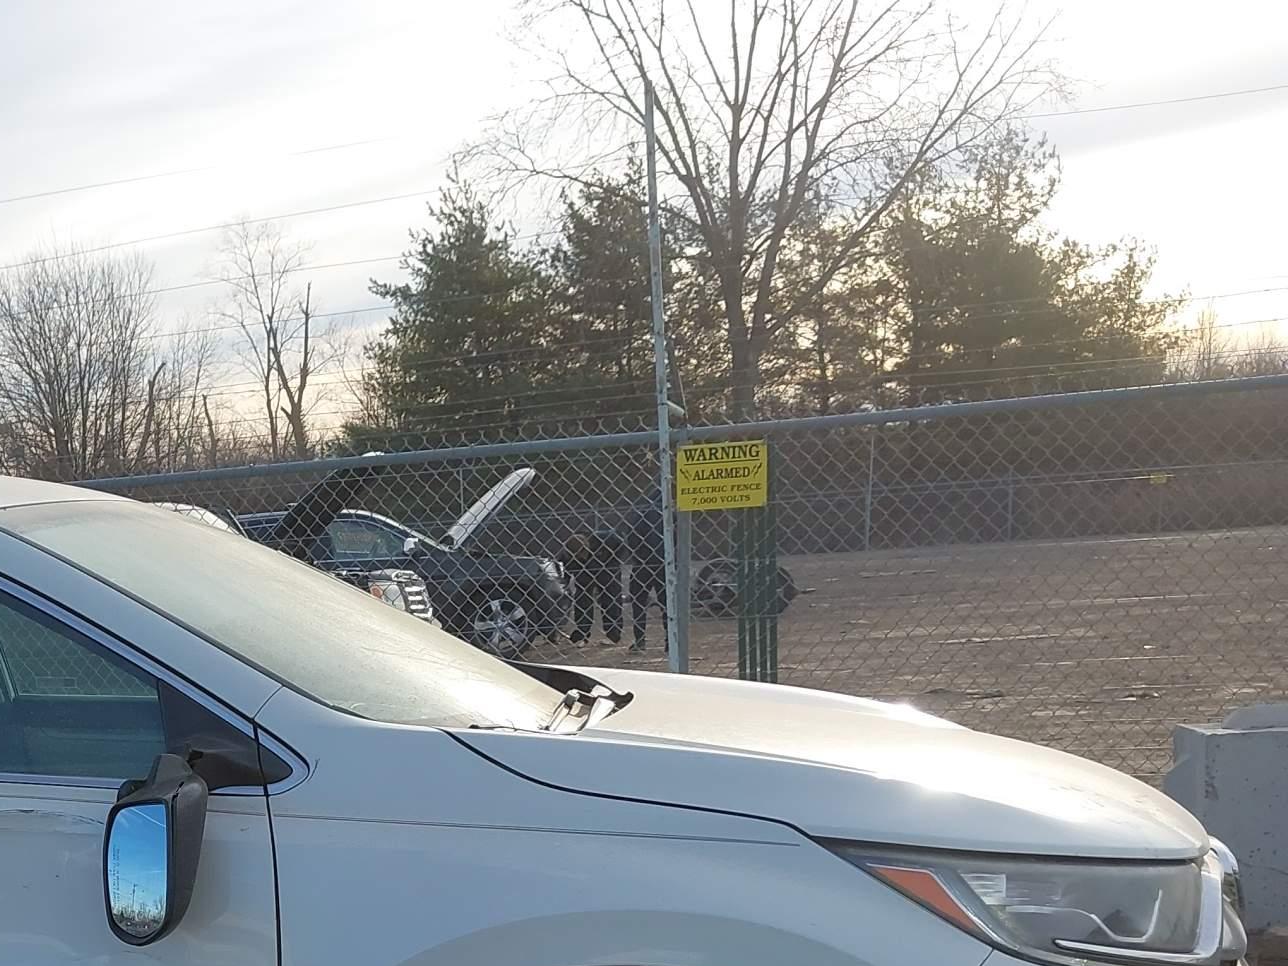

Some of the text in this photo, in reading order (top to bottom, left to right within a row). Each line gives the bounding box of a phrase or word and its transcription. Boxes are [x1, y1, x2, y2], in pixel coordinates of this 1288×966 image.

[684, 444, 760, 462] WARNING
[693, 466, 750, 480] ALARMED
[681, 483, 761, 495] ELECTRIC FENCE
[720, 495, 750, 503] VOLTS
